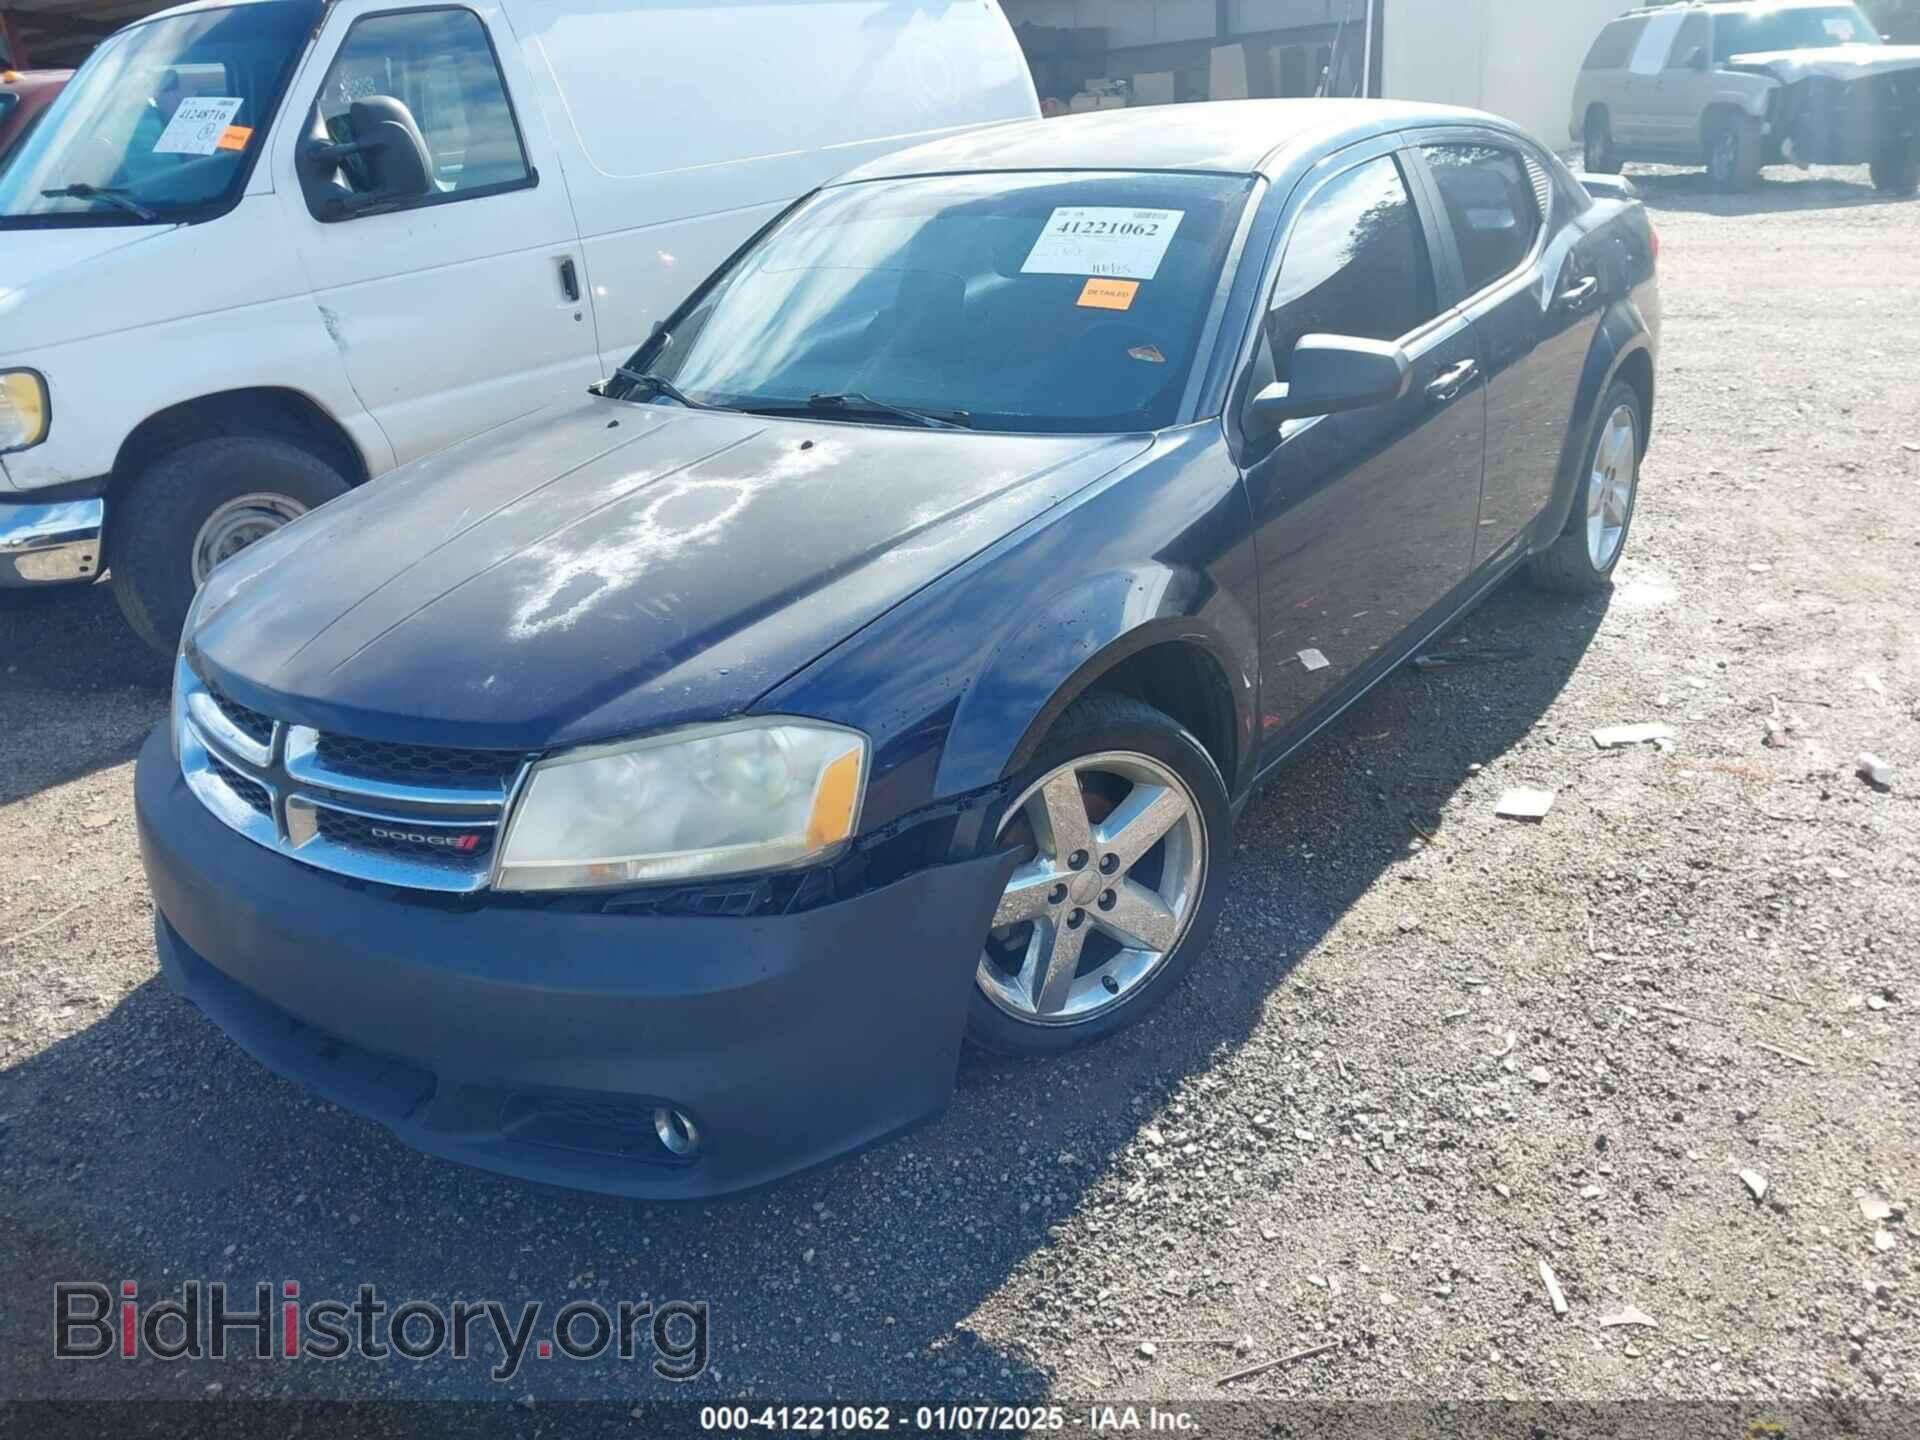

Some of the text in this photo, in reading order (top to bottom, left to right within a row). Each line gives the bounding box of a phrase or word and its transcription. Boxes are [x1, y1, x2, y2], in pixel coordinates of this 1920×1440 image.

[1056, 221, 1159, 236] 41221062
[1087, 288, 1130, 298] DETAILED
[372, 828, 463, 847] DODGE
